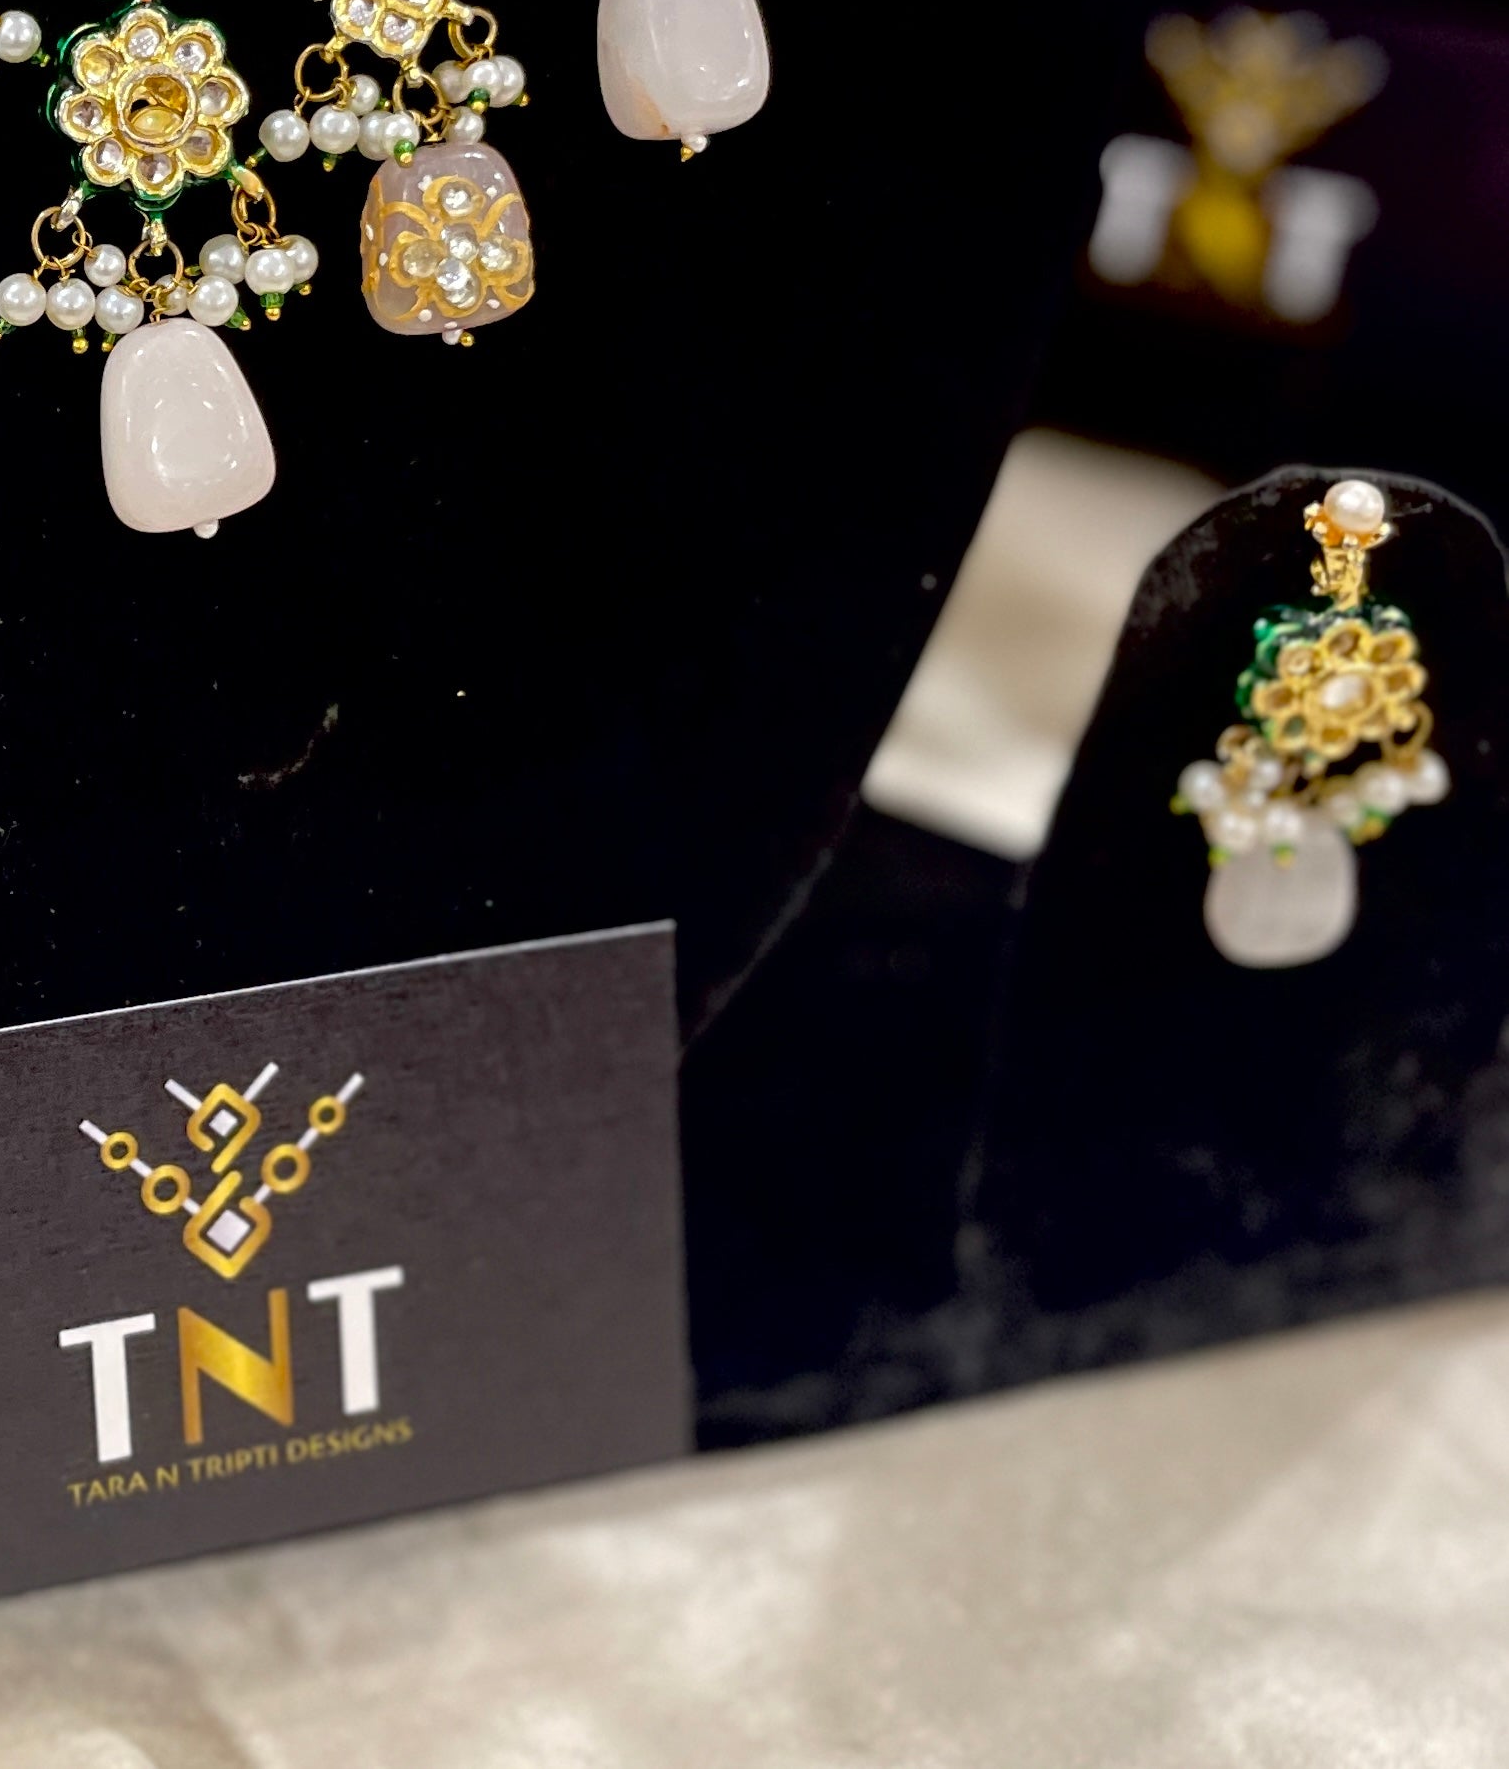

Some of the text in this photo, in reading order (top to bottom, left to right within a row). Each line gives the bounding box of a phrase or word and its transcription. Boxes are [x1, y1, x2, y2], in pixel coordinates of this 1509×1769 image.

[59, 1266, 404, 1463] TNT
[68, 1417, 413, 1508] TARA N TRIPTI DESIGNS
